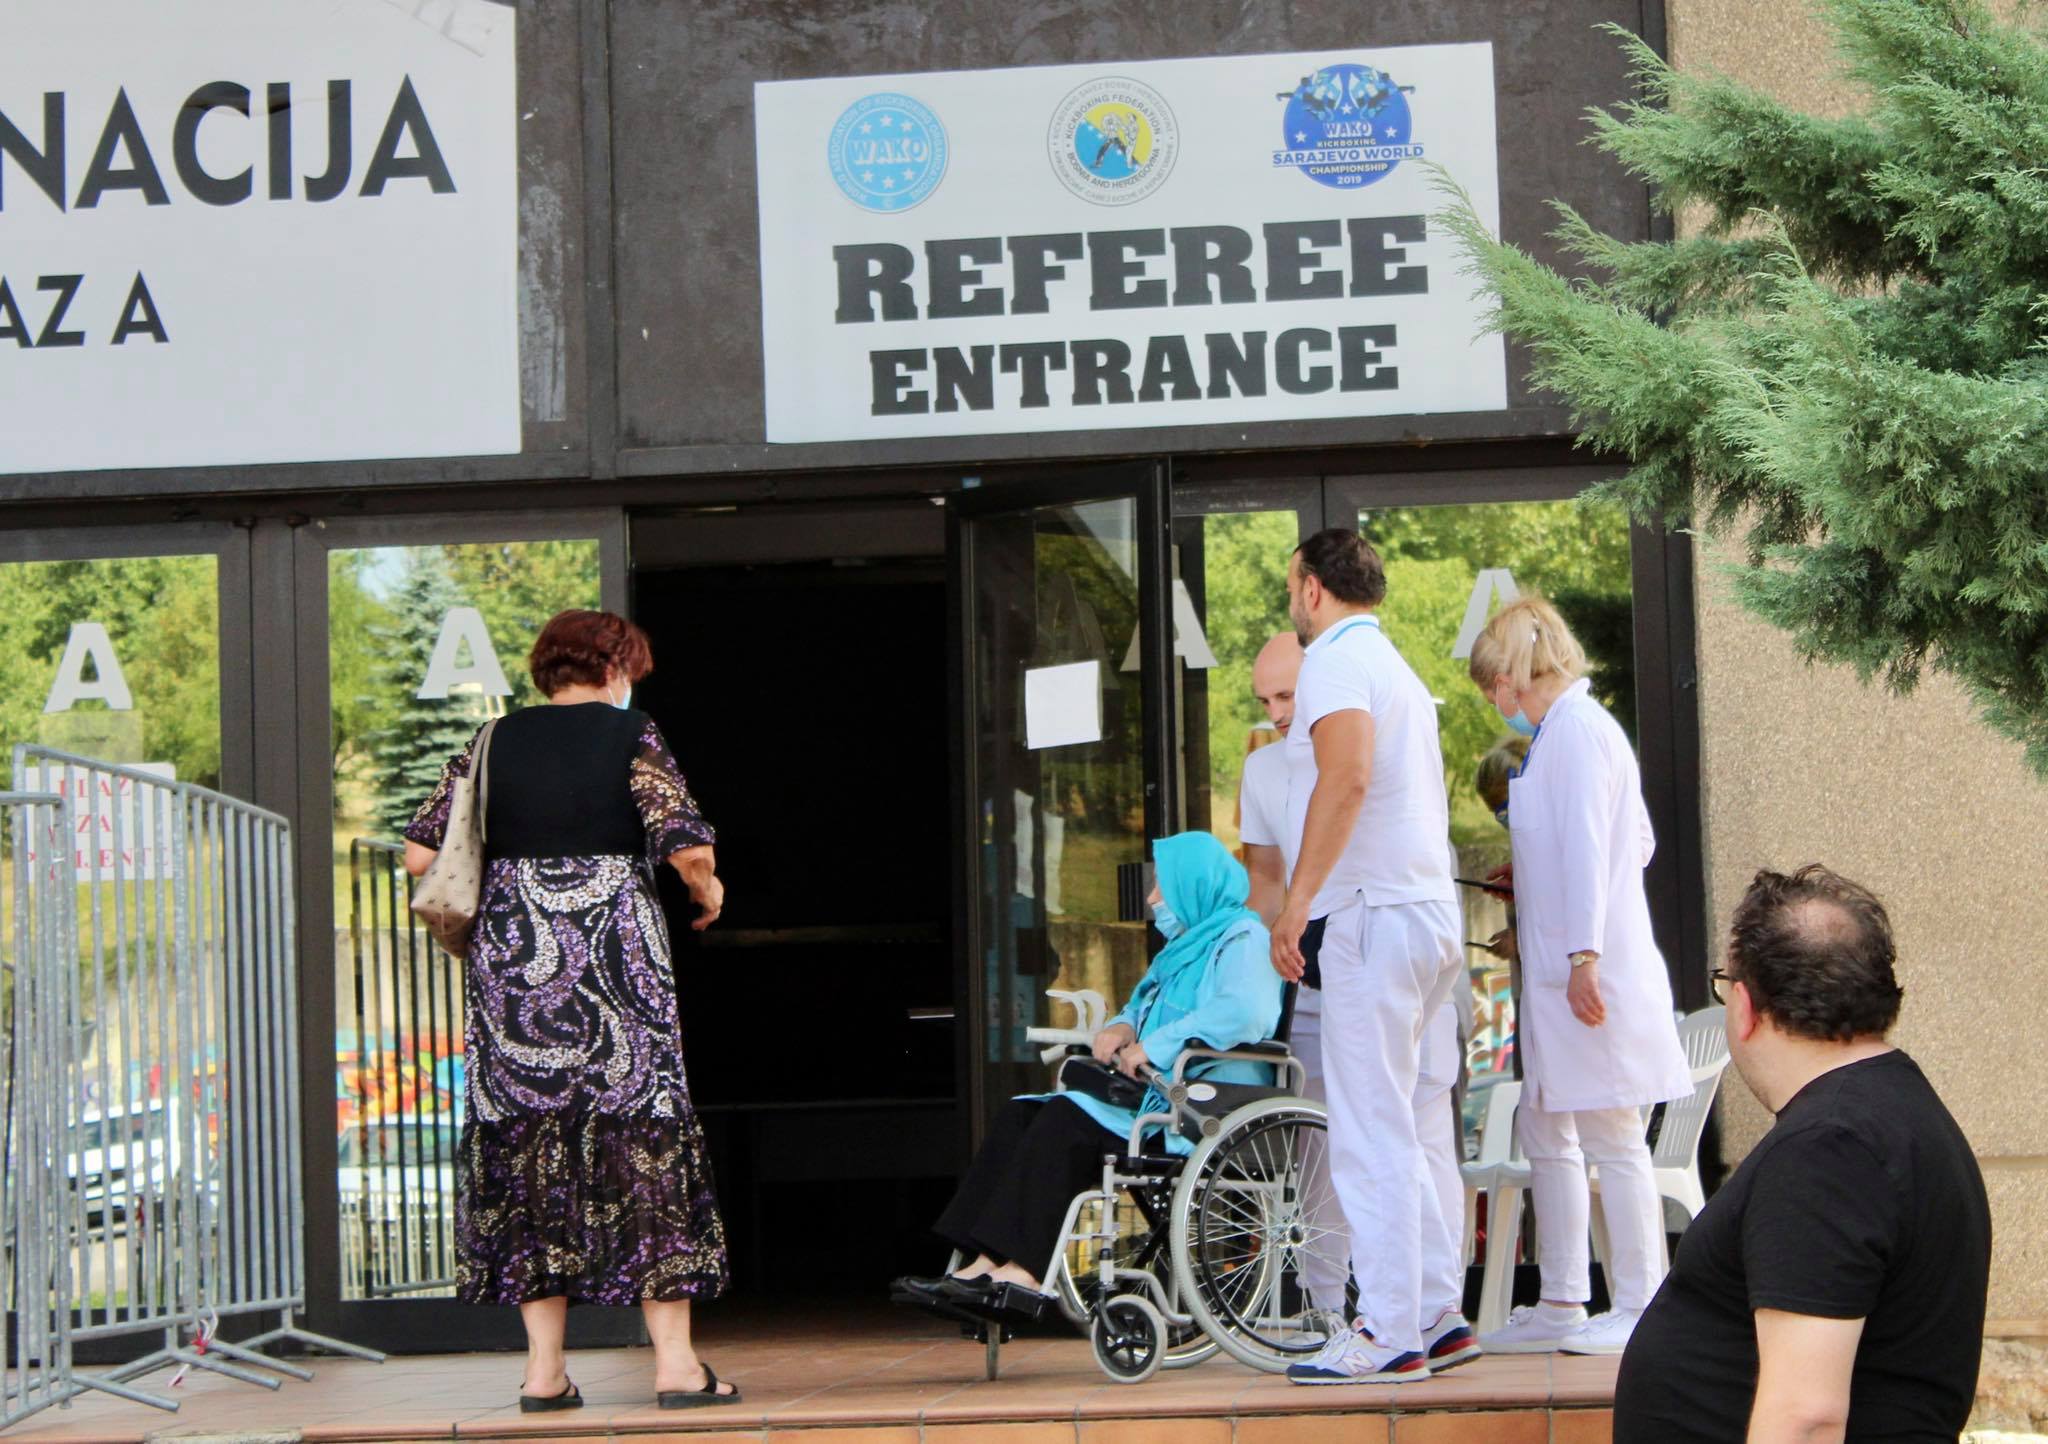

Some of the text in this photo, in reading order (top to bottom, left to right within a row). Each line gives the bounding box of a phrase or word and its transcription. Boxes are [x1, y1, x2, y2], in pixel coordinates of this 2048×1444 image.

[1065, 93, 1161, 139] KICKBOXING FEDERATION
[1324, 121, 1373, 138] WAKO
[0, 73, 457, 214] NACIJA
[851, 138, 929, 165] WAKO
[1272, 145, 1424, 165] SARAJEVO WORLD
[1317, 138, 1377, 148] KICKBOXING
[1066, 151, 1091, 182] BOSNIA
[1089, 176, 1111, 190] AND
[1309, 162, 1389, 175] CHAMPIONSHIP
[1337, 175, 1362, 185] 2019
[832, 215, 1429, 323] REFEREE
[869, 324, 1399, 416] ENTRANCE
[43, 622, 133, 714] A
[416, 607, 513, 700] A
